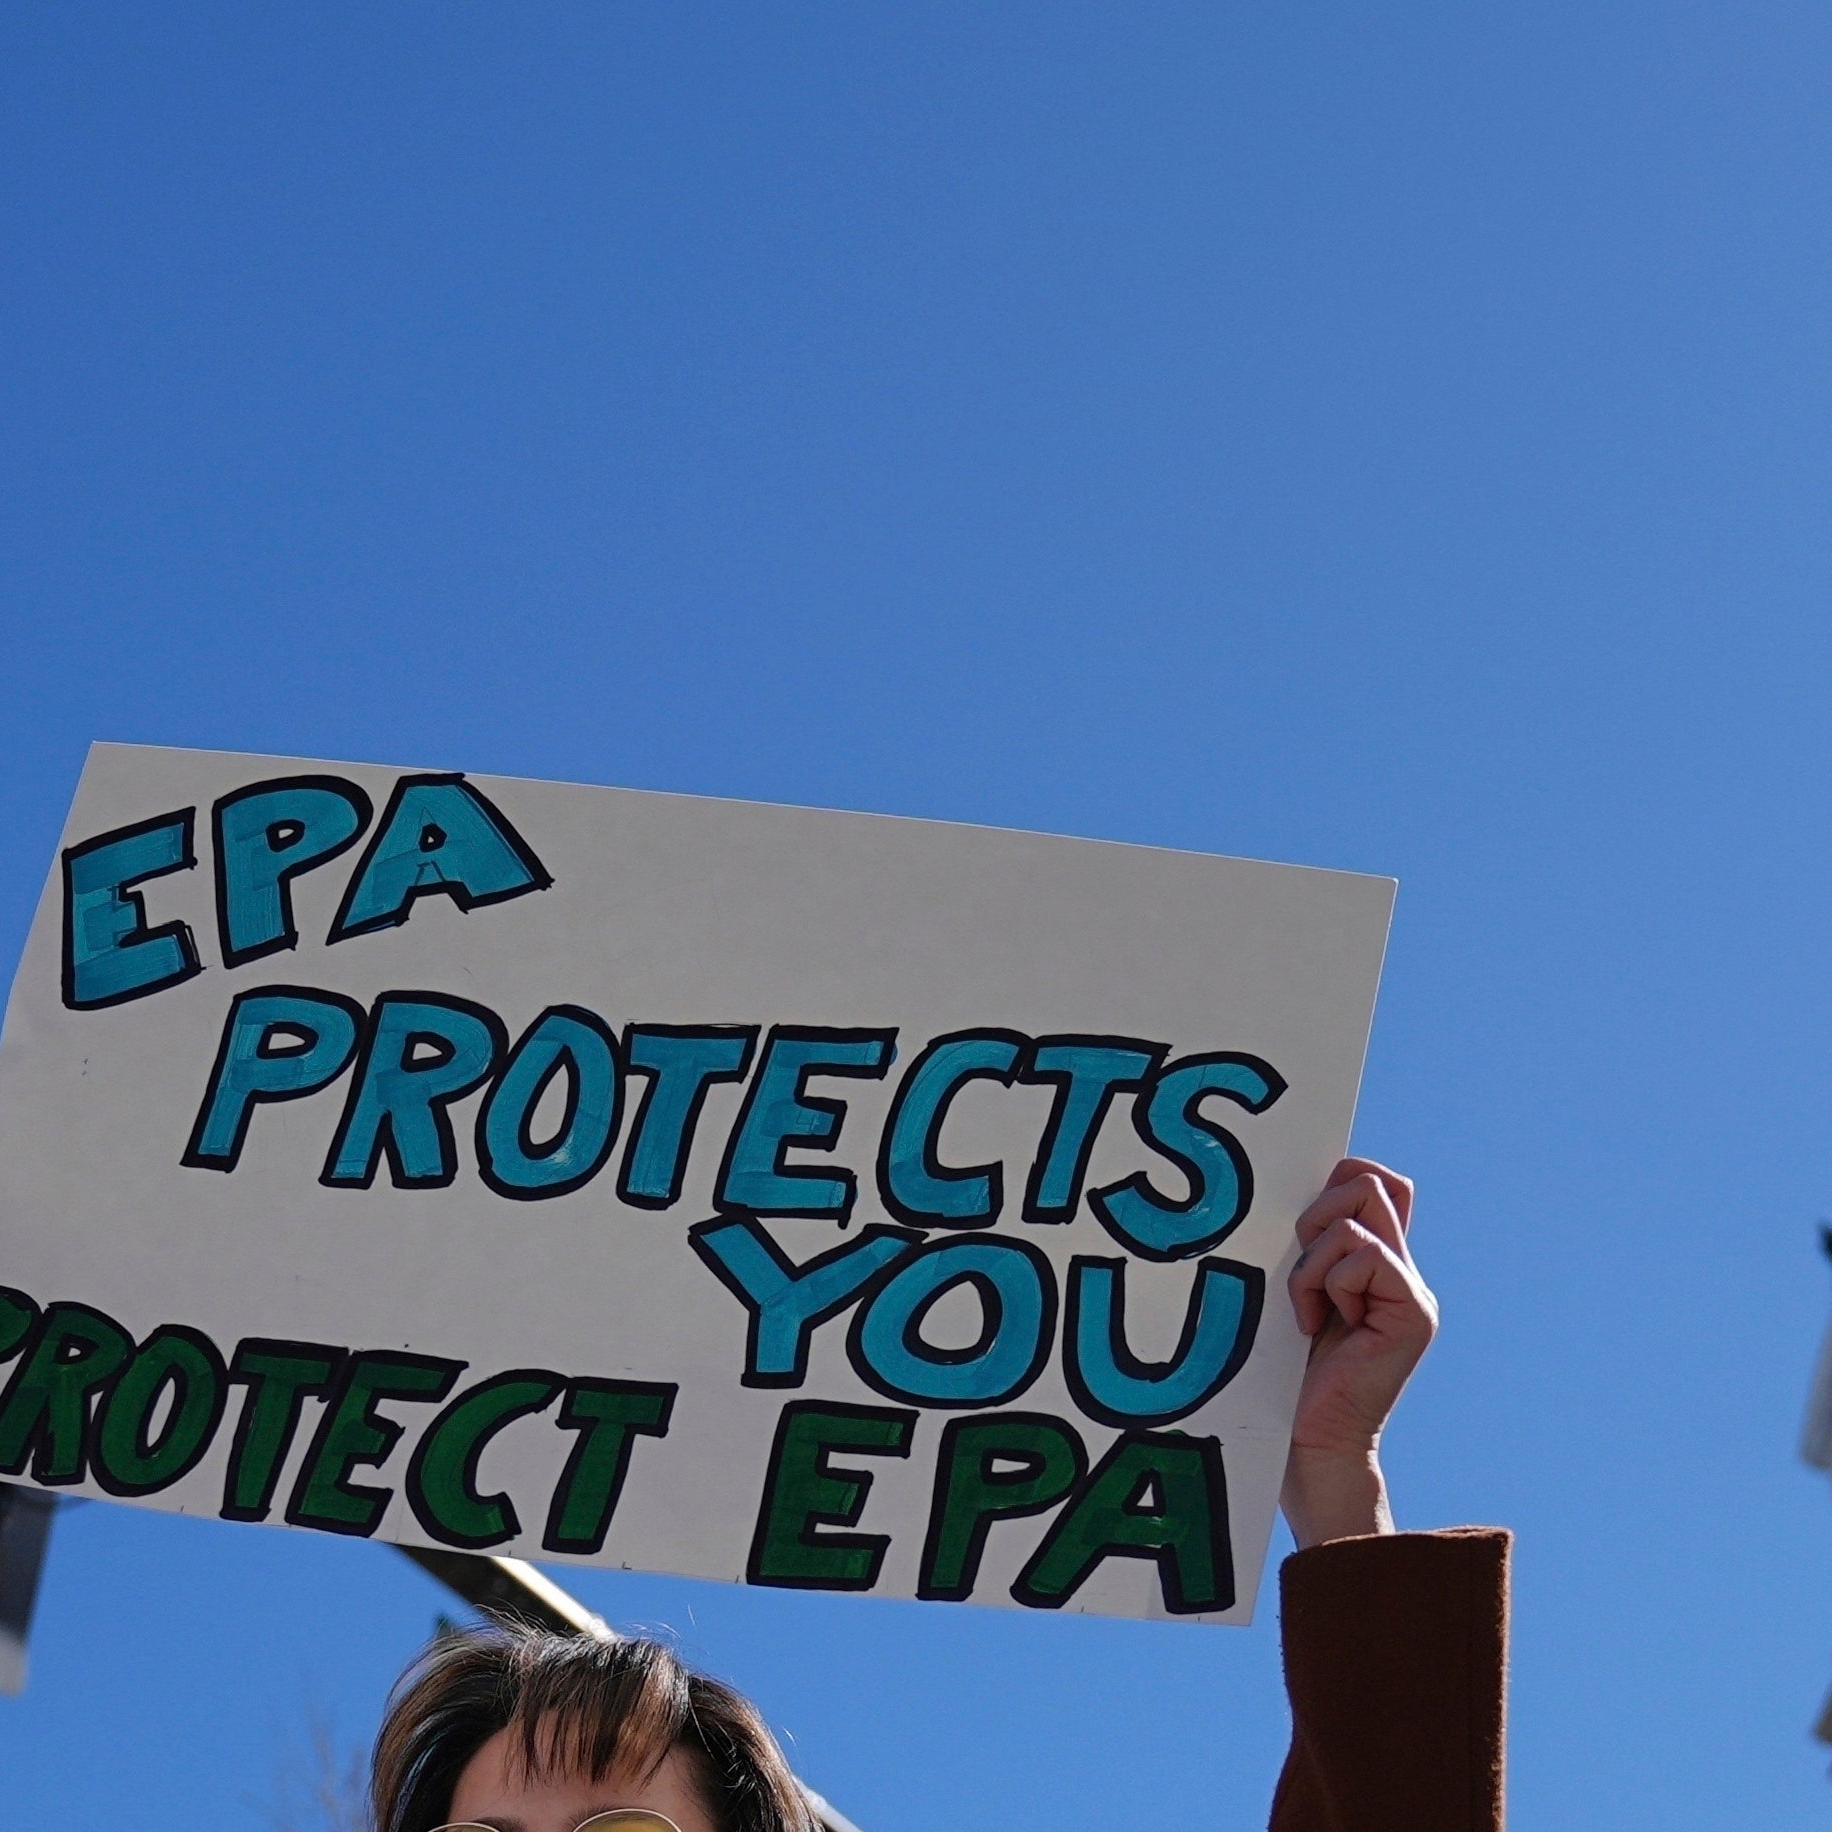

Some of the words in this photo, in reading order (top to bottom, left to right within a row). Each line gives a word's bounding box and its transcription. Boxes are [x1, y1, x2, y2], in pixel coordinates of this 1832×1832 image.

[61, 773, 554, 1010] EPA
[182, 985, 1287, 1259] PROTECTS
[690, 1215, 1265, 1428] YOU
[746, 1399, 1236, 1617] EPA
